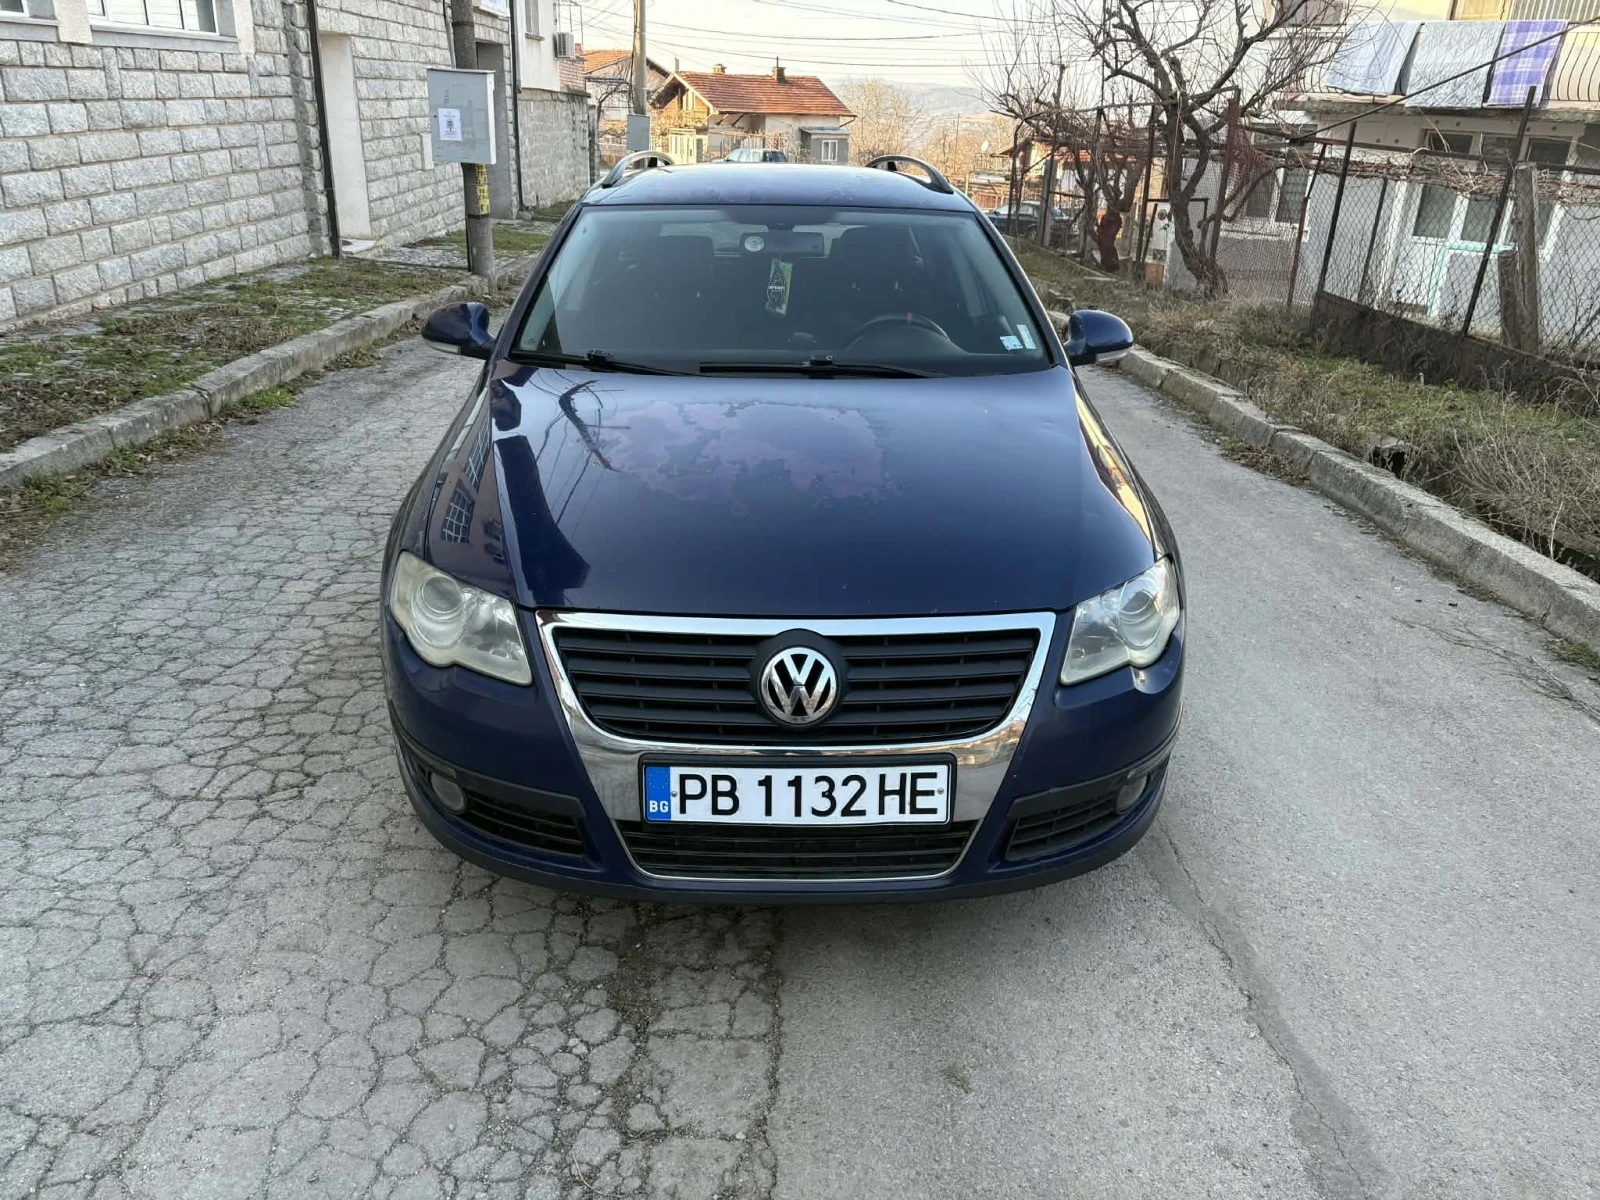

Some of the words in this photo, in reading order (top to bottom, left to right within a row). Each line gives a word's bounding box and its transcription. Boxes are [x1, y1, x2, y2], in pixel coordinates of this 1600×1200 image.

[762, 648, 836, 723] VW
[649, 801, 669, 813] BG
[679, 774, 740, 815] PB
[758, 775, 867, 817] 1132
[878, 772, 938, 815] HE
